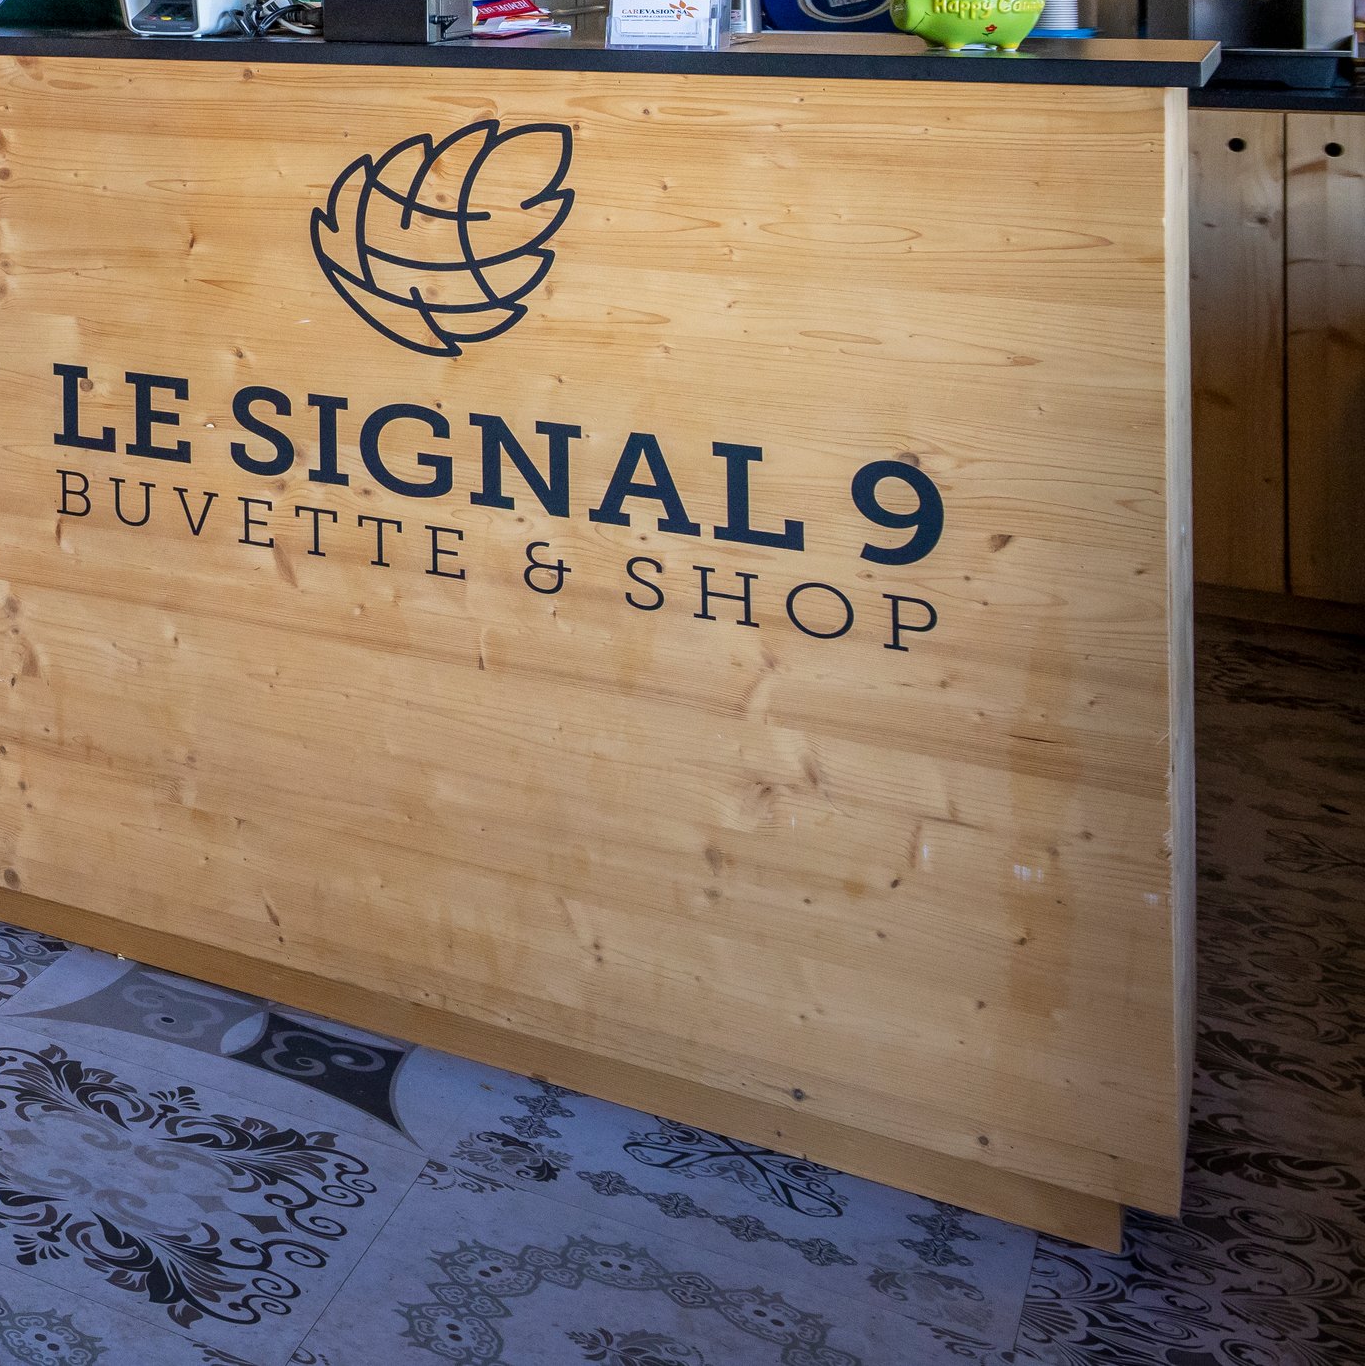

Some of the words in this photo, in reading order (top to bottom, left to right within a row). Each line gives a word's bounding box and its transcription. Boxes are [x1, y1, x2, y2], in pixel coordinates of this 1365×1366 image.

[495, 0, 529, 11] REMOVE
[53, 362, 191, 465] LE
[230, 384, 804, 553] SIGNAL
[850, 460, 943, 566] 9
[55, 470, 467, 582] BUVETTE
[523, 541, 573, 596] &
[625, 556, 939, 654] SHOP
